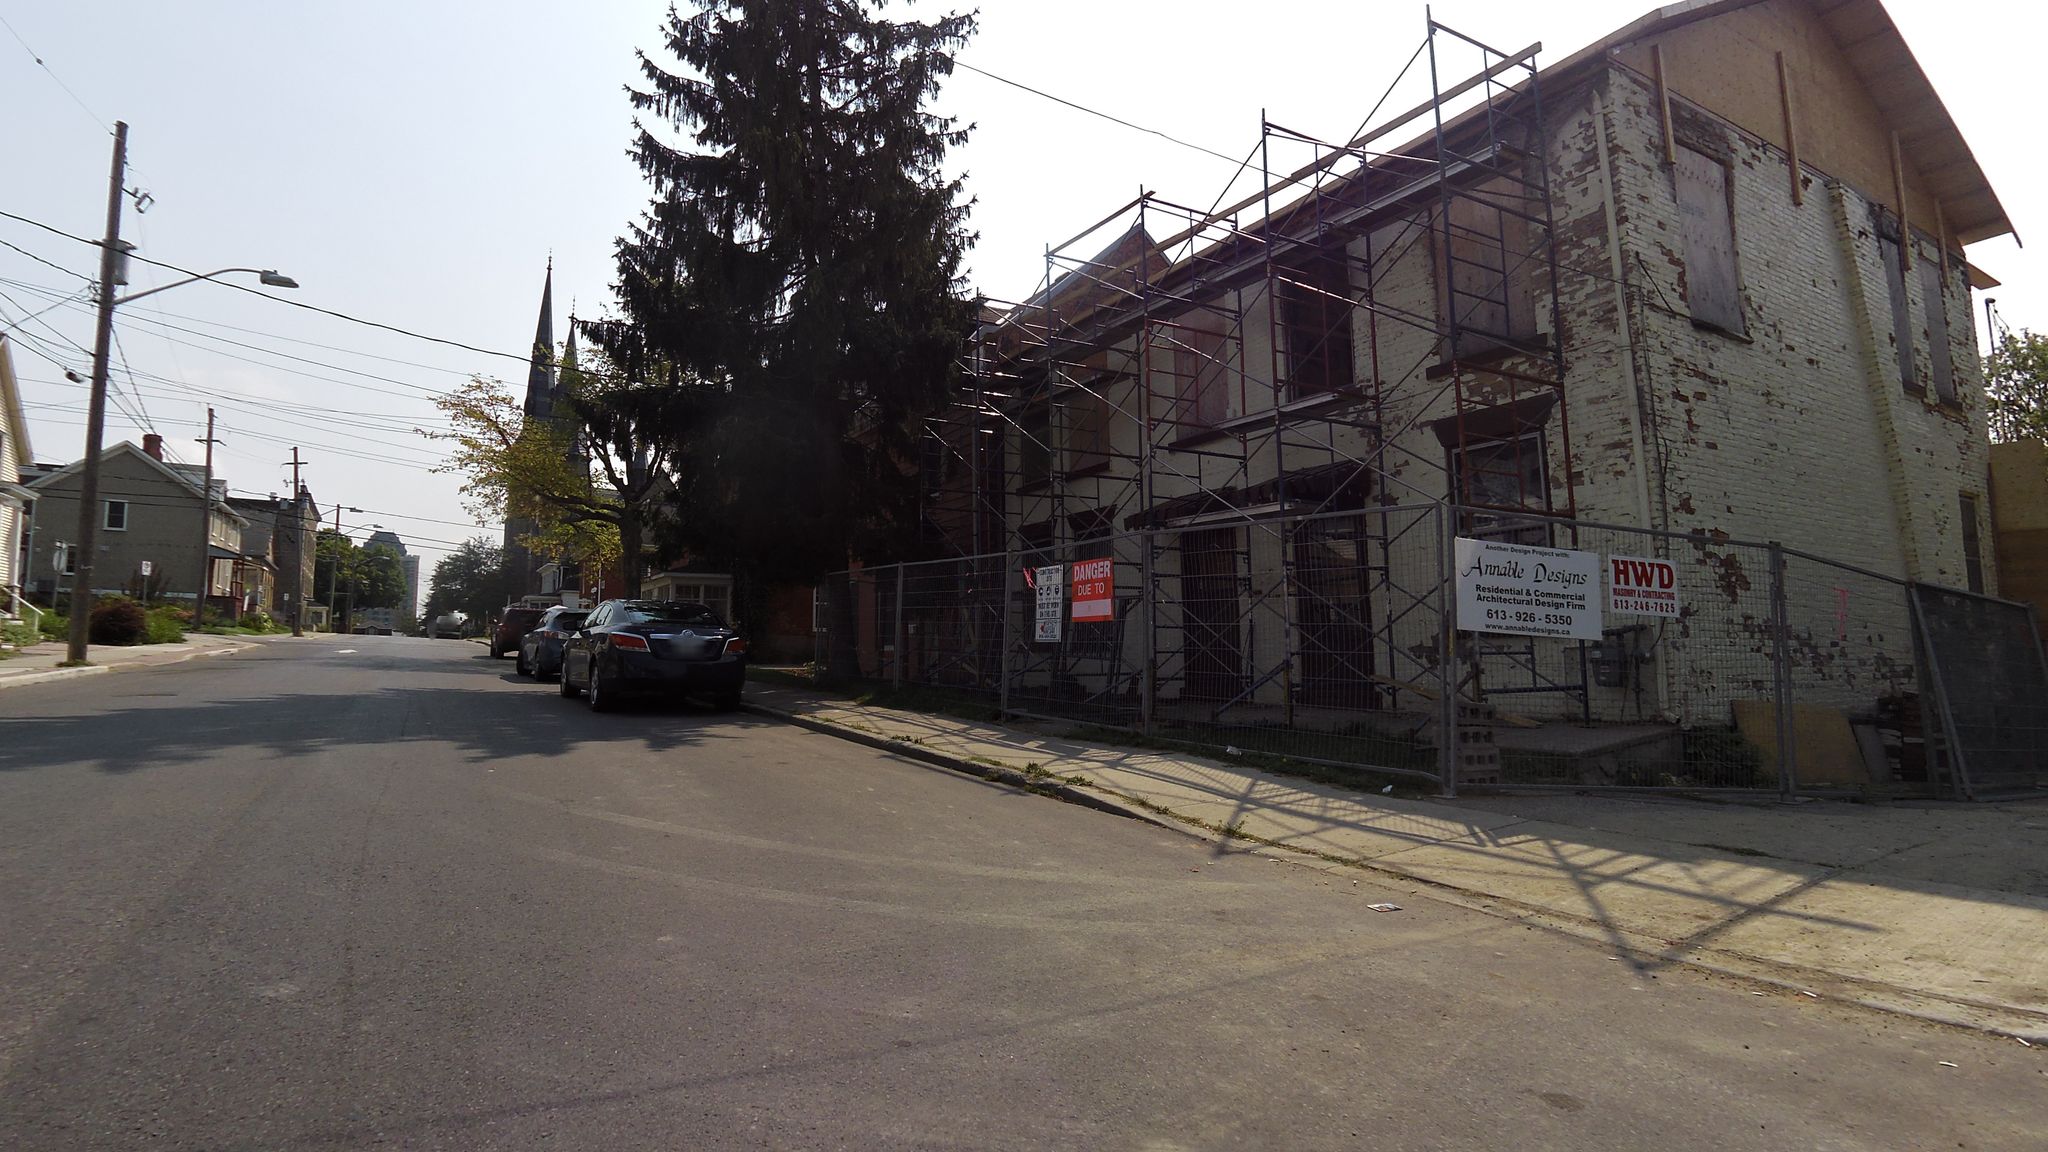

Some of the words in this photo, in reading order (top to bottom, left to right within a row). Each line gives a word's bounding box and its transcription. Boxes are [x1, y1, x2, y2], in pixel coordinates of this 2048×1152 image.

[1485, 544, 1509, 553] Another
[1510, 547, 1531, 555] Design
[1532, 549, 1554, 557] Project
[1074, 561, 1111, 581] DANGER
[1461, 556, 1524, 579] Annable
[1533, 563, 1588, 589] Designs
[1611, 559, 1674, 589] HWD
[1077, 584, 1092, 596] DUE
[1094, 582, 1105, 594] TO
[1475, 584, 1524, 597] Residential
[1525, 589, 1532, 597] &
[1534, 589, 1585, 601] Commercial
[1476, 594, 1533, 606] Architectural
[1535, 598, 1565, 609] Design
[1566, 602, 1586, 611] Firm
[1485, 623, 1570, 635] www.annabledesigns.ca
